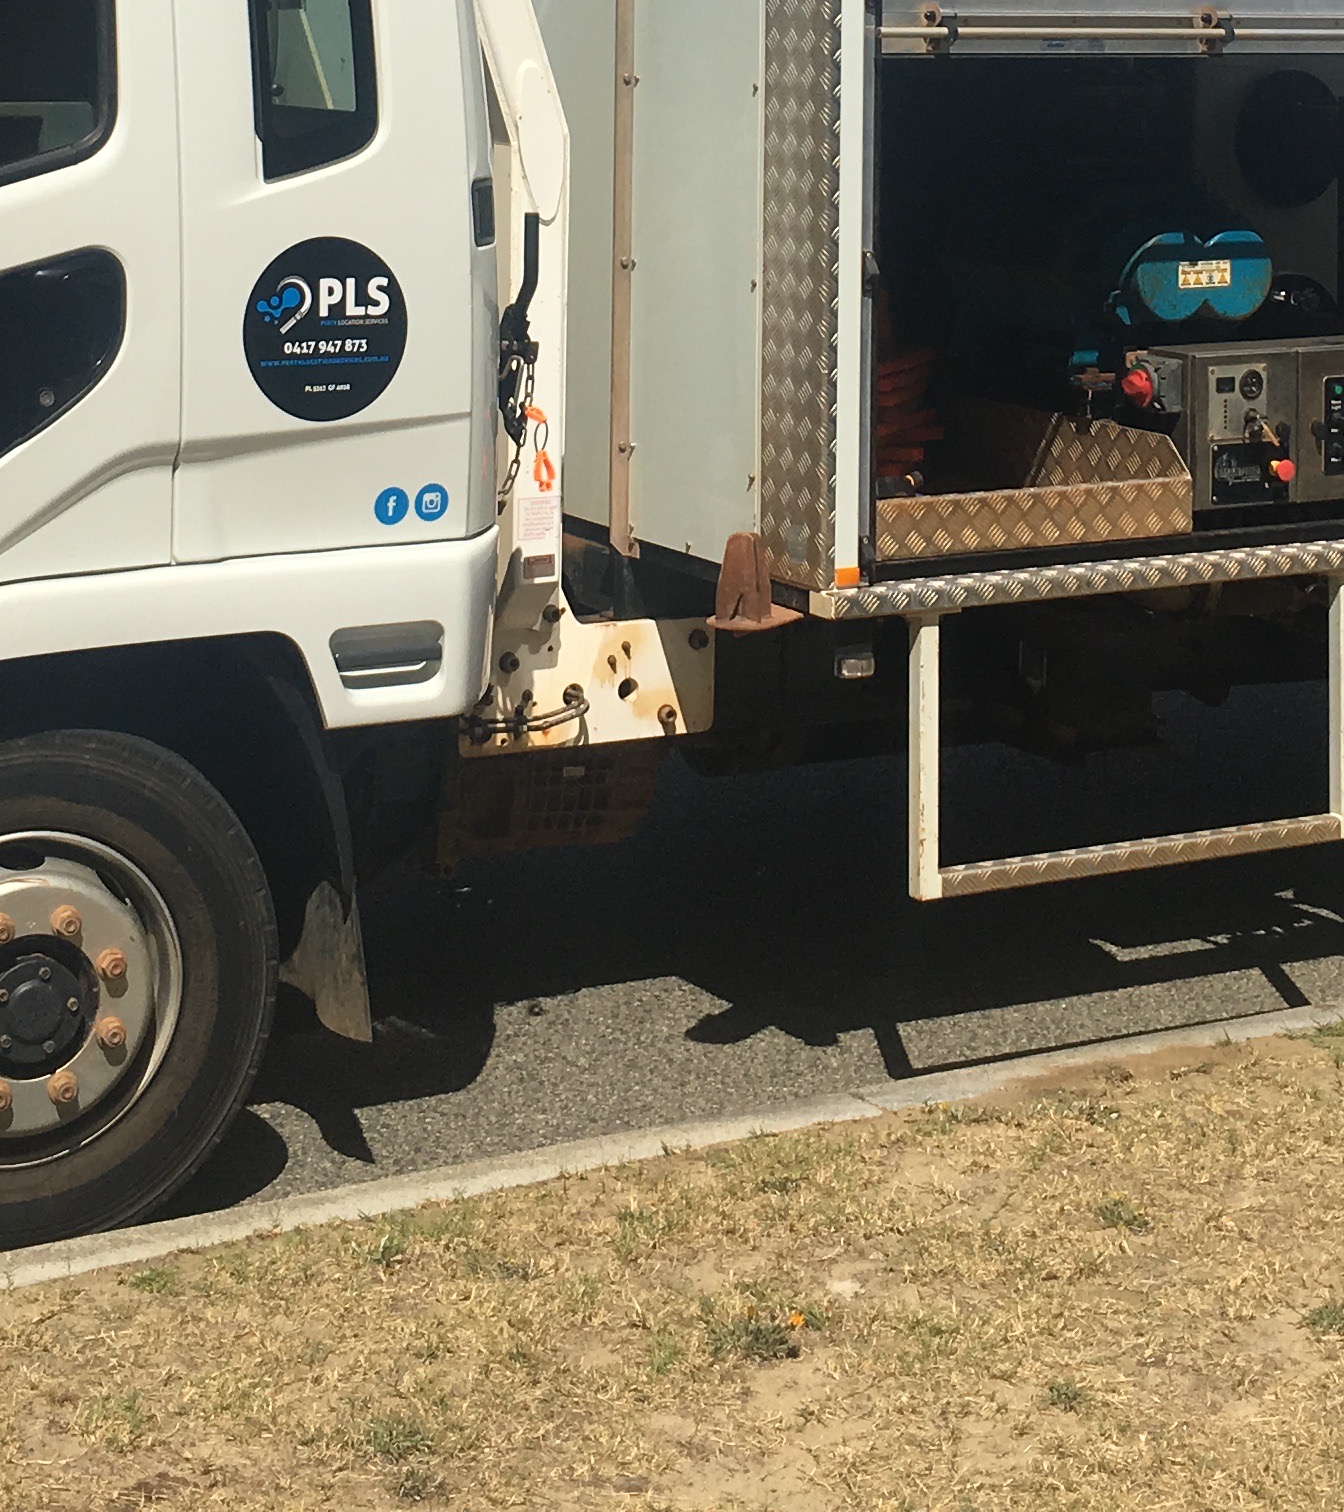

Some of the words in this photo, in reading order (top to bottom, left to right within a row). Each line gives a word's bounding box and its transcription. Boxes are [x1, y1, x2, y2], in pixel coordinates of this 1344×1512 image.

[319, 276, 390, 317] PLS
[284, 341, 316, 354] 0417
[318, 340, 342, 353] 947
[344, 338, 368, 352] 873
